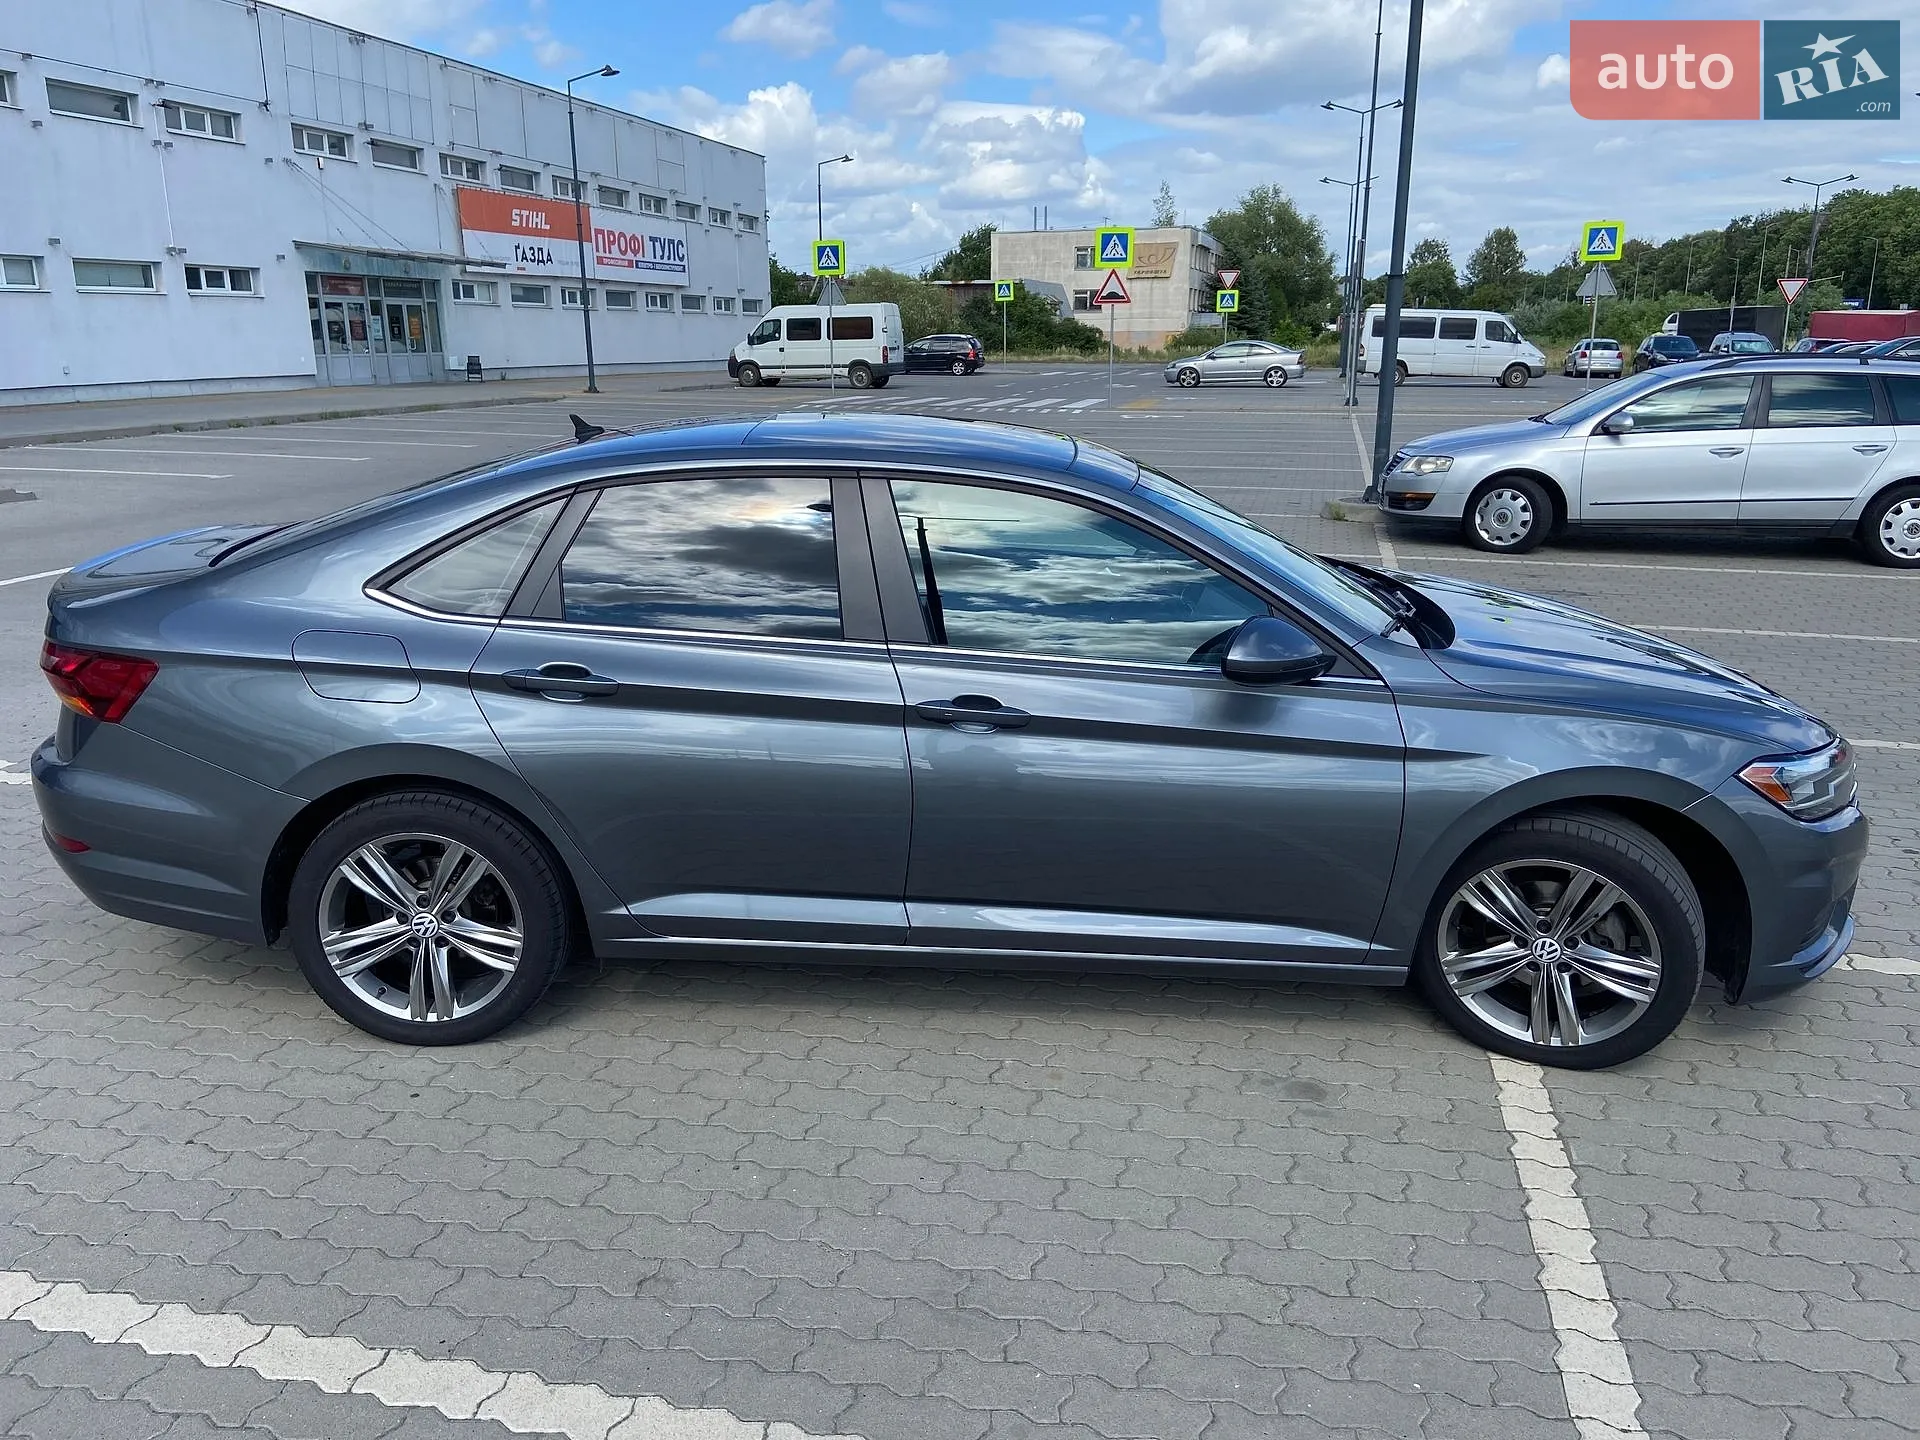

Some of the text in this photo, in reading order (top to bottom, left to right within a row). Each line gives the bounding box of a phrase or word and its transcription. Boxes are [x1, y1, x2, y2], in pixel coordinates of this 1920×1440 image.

[511, 208, 550, 230] STIHL
[514, 242, 554, 266] ҐАЗДА
[594, 228, 685, 263] ПРОФІ ТУЛС
